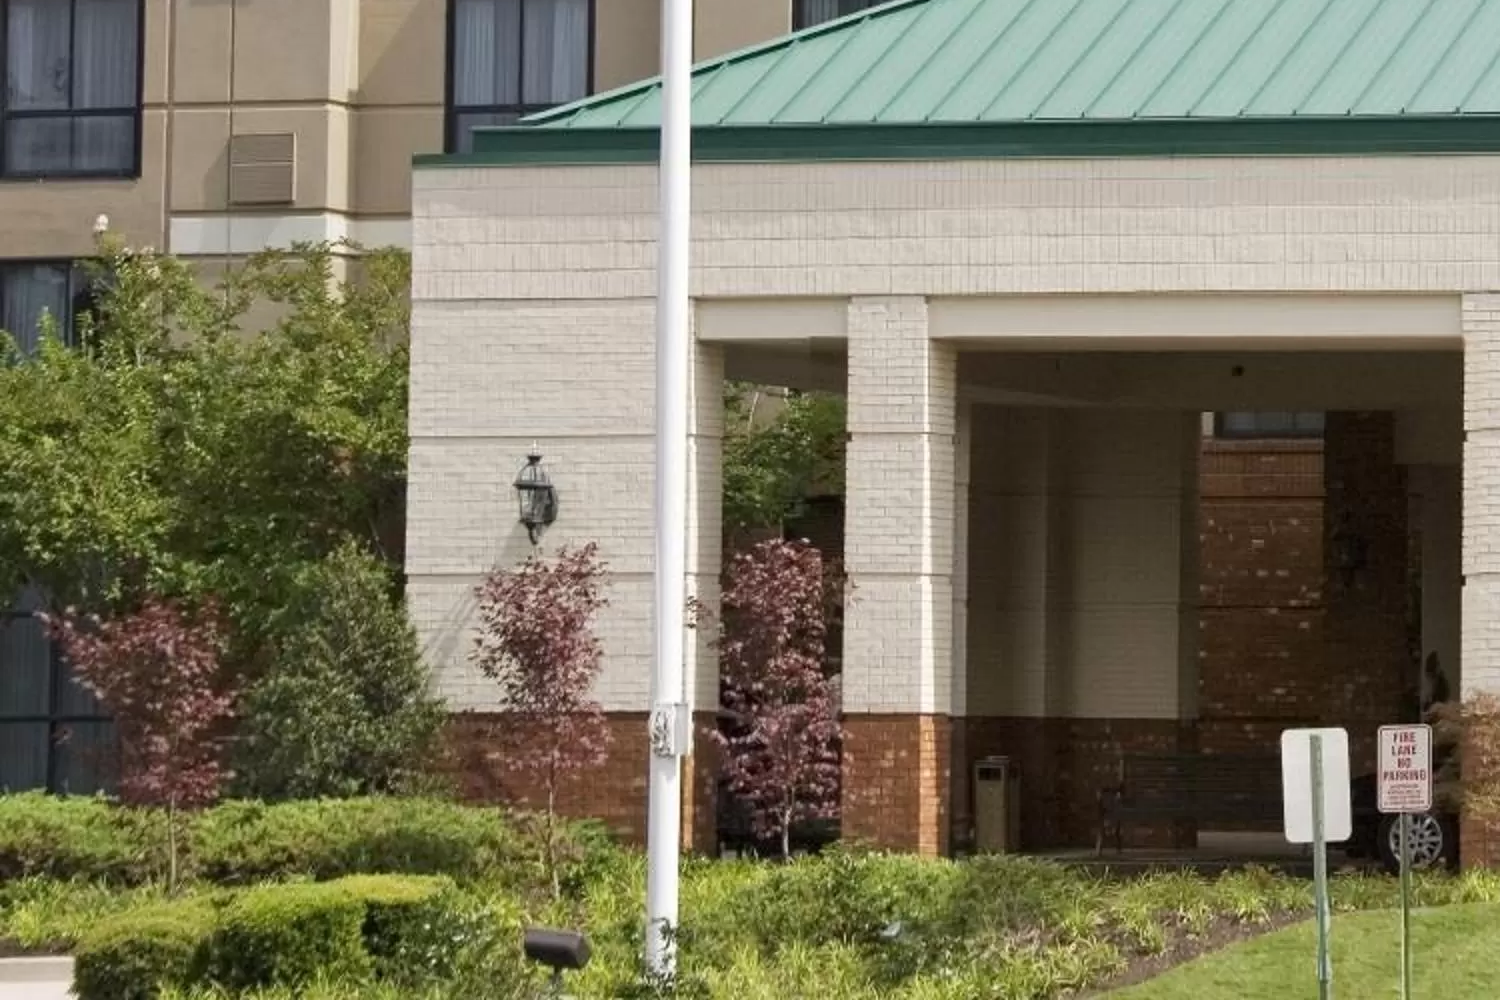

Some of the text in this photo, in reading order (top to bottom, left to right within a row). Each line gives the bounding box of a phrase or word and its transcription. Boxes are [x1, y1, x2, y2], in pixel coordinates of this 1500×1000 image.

[1393, 732, 1416, 743] FIRE
[1391, 745, 1417, 756] LANE
[1397, 758, 1412, 768] NO
[1383, 769, 1427, 781] PARKING
